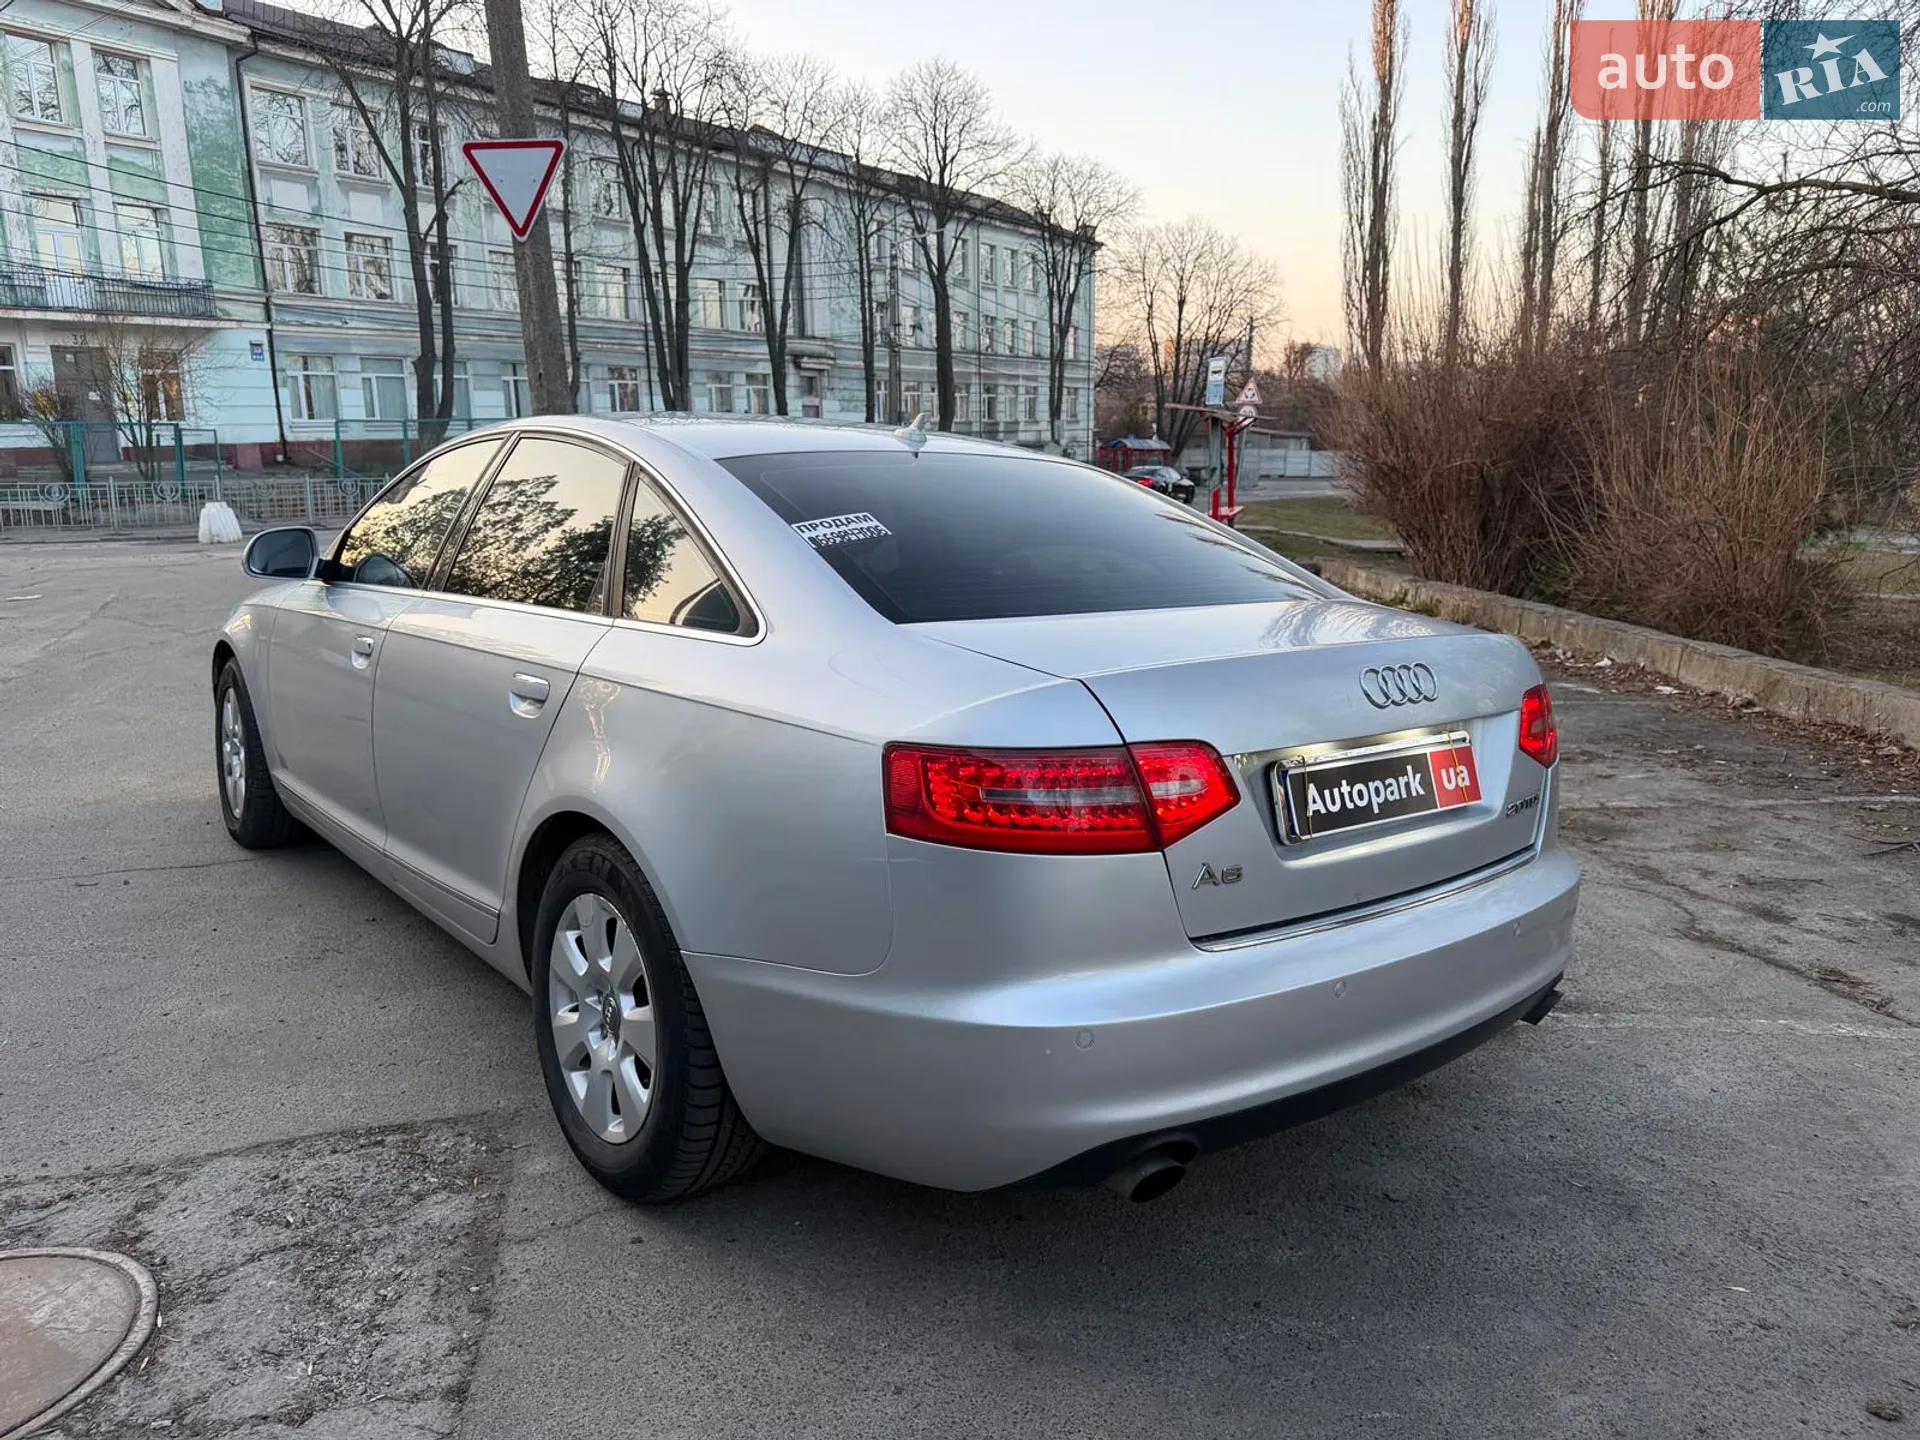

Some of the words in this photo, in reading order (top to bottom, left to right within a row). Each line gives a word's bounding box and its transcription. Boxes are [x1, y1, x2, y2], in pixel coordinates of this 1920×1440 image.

[795, 514, 874, 534] ПРОДАМ
[1306, 765, 1425, 814] Autopark
[1440, 764, 1470, 790] ua
[1191, 862, 1243, 890] A6
